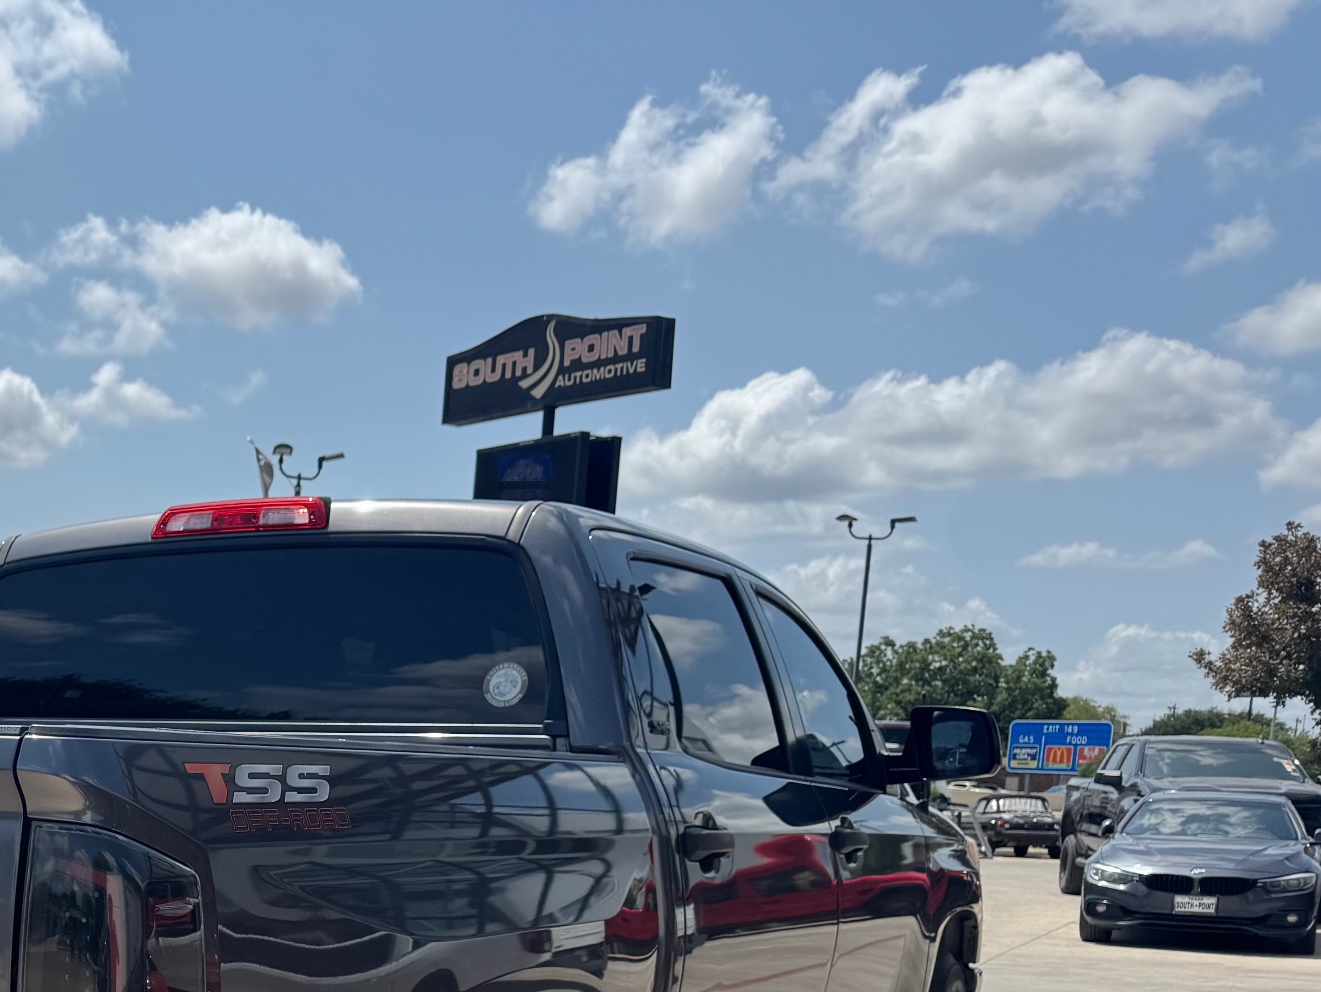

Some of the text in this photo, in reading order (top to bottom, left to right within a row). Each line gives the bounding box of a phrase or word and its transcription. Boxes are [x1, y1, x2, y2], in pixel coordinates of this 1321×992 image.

[452, 323, 647, 390] SOUTH POINT
[555, 358, 646, 389] AUTOMOTIVE
[1019, 735, 1034, 743] GAS
[1043, 725, 1060, 733] EXIT
[1066, 735, 1087, 744] FOOD
[184, 763, 331, 804] TSS
[229, 807, 352, 832] OFF-ROAD
